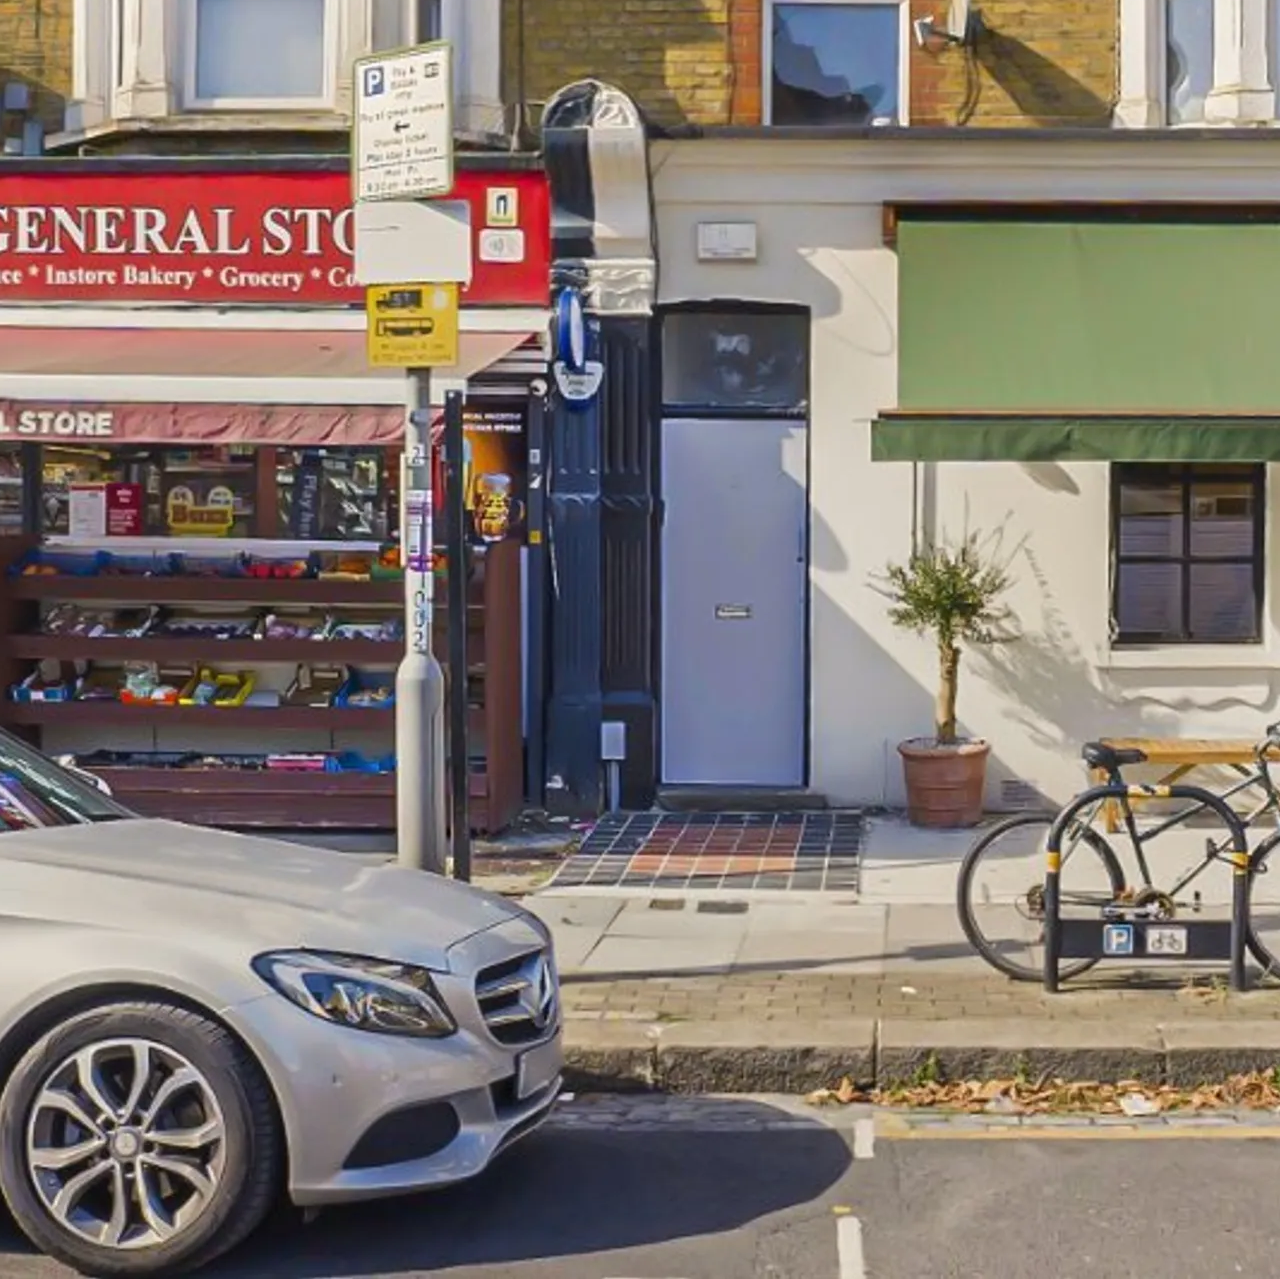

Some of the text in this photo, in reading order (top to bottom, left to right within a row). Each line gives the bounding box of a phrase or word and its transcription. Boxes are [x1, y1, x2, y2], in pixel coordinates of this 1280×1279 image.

[367, 70, 381, 94] P
[45, 265, 117, 285] Instore
[123, 266, 197, 290] Bakery
[220, 266, 304, 291] Grocery
[17, 411, 114, 436] STORE
[1110, 927, 1129, 951] P
